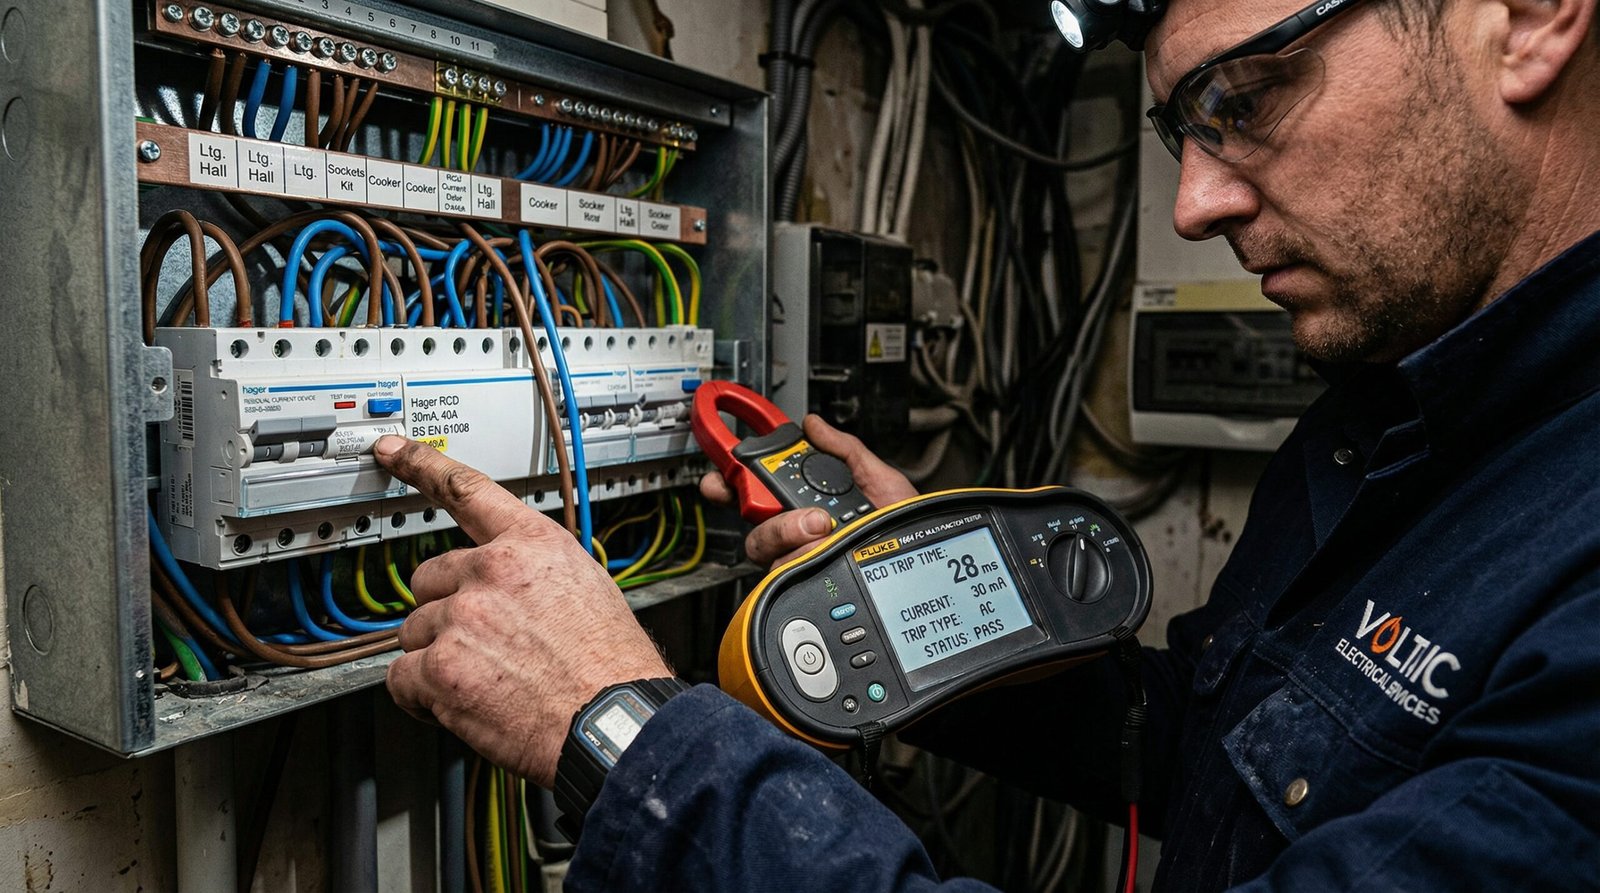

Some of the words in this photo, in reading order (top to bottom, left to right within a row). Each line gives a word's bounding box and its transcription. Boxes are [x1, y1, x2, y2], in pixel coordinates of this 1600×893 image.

[322, 0, 329, 9] 3
[345, 7, 351, 15] 4
[368, 13, 374, 22] 5
[390, 19, 396, 28] 6
[411, 25, 417, 33] 7
[431, 30, 437, 39] 8
[450, 36, 461, 45] 10
[470, 41, 480, 51] 11
[200, 143, 226, 161] Ltg.
[248, 150, 273, 167] Ltg.
[200, 162, 227, 177] Hall
[248, 168, 274, 183] Hall
[294, 164, 317, 180] Ltg.
[328, 164, 365, 178] Sockets
[340, 181, 354, 191] Kit
[368, 175, 401, 188] Cooker
[405, 182, 437, 194] Cooker
[477, 183, 495, 197] Ltg.
[477, 198, 496, 210] Hall
[529, 197, 558, 210] Cooker
[620, 217, 636, 227] Hall
[242, 386, 267, 395] hager
[377, 380, 399, 389] hager
[411, 398, 437, 409] Hager
[439, 395, 459, 406] RCD
[441, 409, 458, 420] 40A
[412, 426, 425, 437] BS
[428, 425, 441, 436] EN
[443, 423, 469, 434] 61008
[860, 541, 896, 558] FLUKE
[915, 531, 925, 540] FC
[864, 566, 889, 584] RCD
[889, 556, 915, 575] TRIP
[917, 546, 949, 566] TIME:
[948, 554, 979, 584] 28
[981, 562, 999, 574] ms
[900, 594, 956, 622] CURRENT:
[971, 583, 987, 598] 30
[988, 576, 1007, 592] mA
[902, 624, 927, 644] TRIP
[929, 612, 963, 633] TYPE:
[979, 601, 996, 617] AC
[924, 631, 971, 658] STATUS:
[974, 619, 1005, 640] PASS
[1335, 638, 1392, 690] ELECTRICAL
